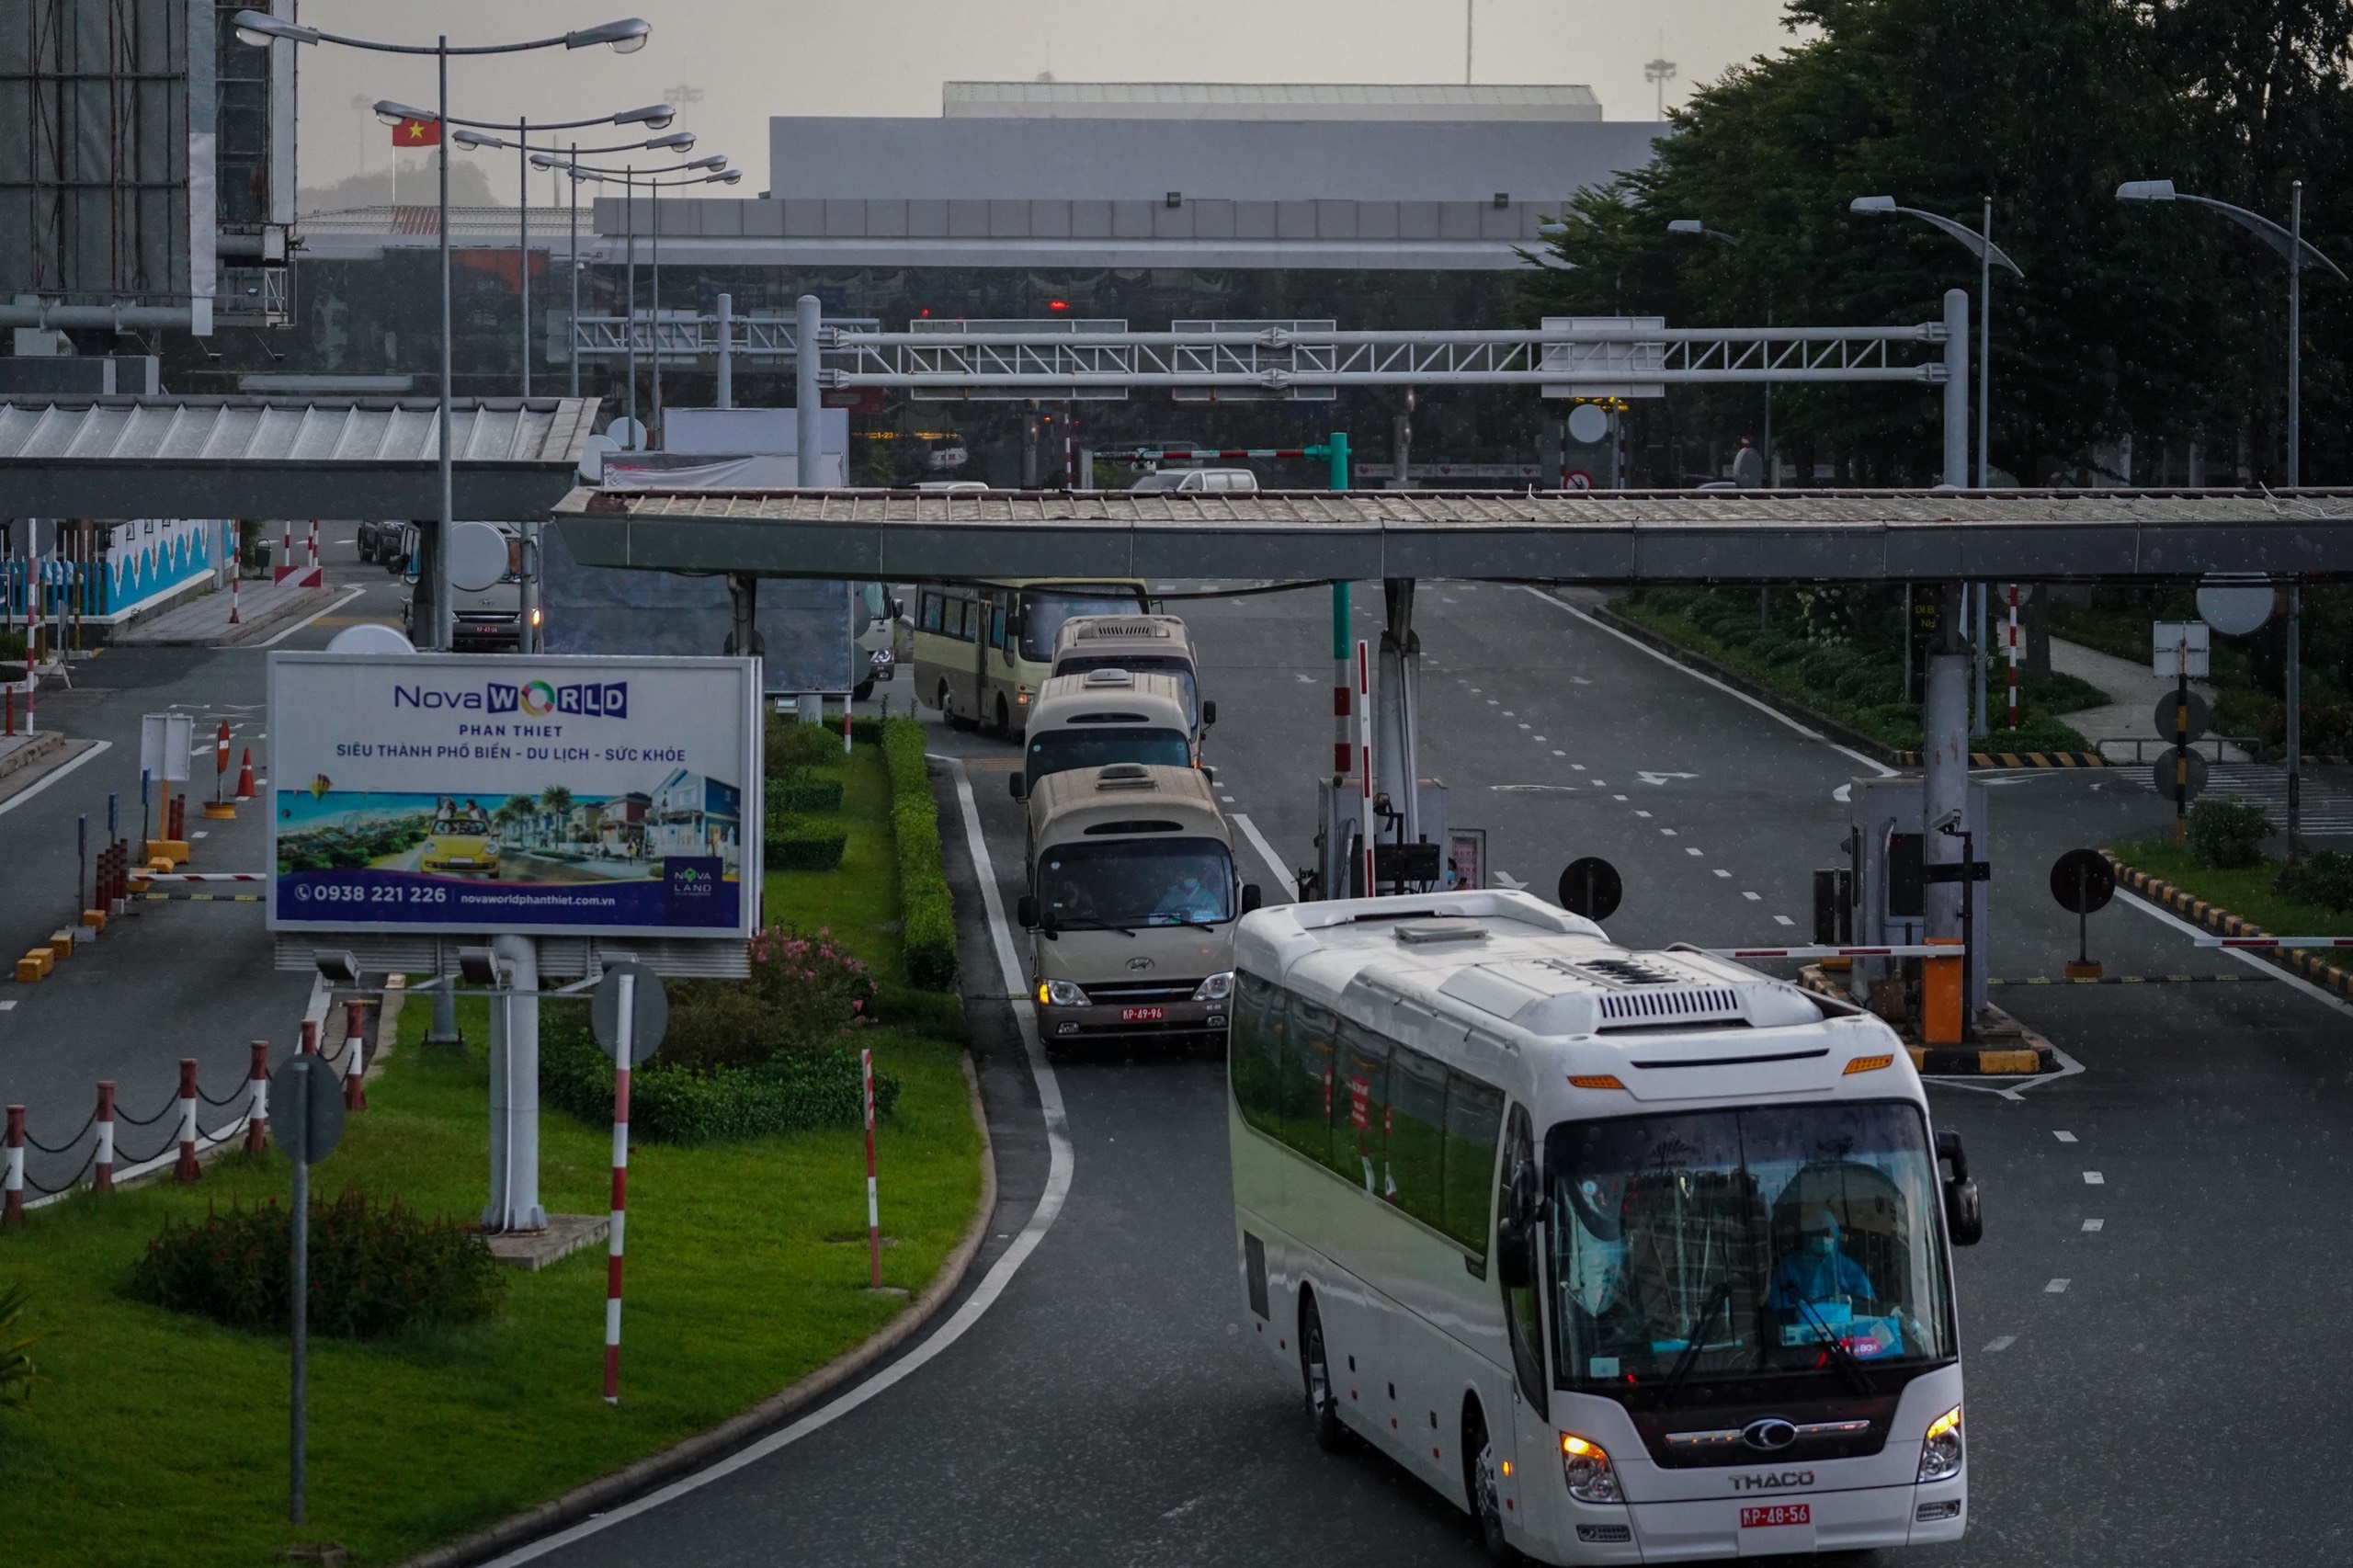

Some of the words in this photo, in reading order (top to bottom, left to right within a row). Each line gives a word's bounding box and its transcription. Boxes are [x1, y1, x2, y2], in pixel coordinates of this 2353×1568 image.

[460, 724, 506, 736] PHAN
[513, 725, 563, 737] THIET
[336, 742, 372, 757] SIÊU
[378, 743, 432, 758] THÀNH
[438, 742, 470, 759] PHỐ
[527, 748, 549, 760] DU
[553, 748, 589, 763] LỊCH
[606, 745, 638, 761] SỨC
[674, 867, 712, 882] NOVA
[313, 885, 365, 902] 0938
[370, 886, 404, 903] 221
[409, 887, 447, 903] 226
[460, 894, 615, 907] novaworldphanthiet.com.vn
[674, 883, 712, 892] LAND
[1122, 1007, 1163, 1019] KP-49-96
[1728, 1471, 1814, 1490] THACO
[1743, 1506, 1808, 1526] KP-48-56
